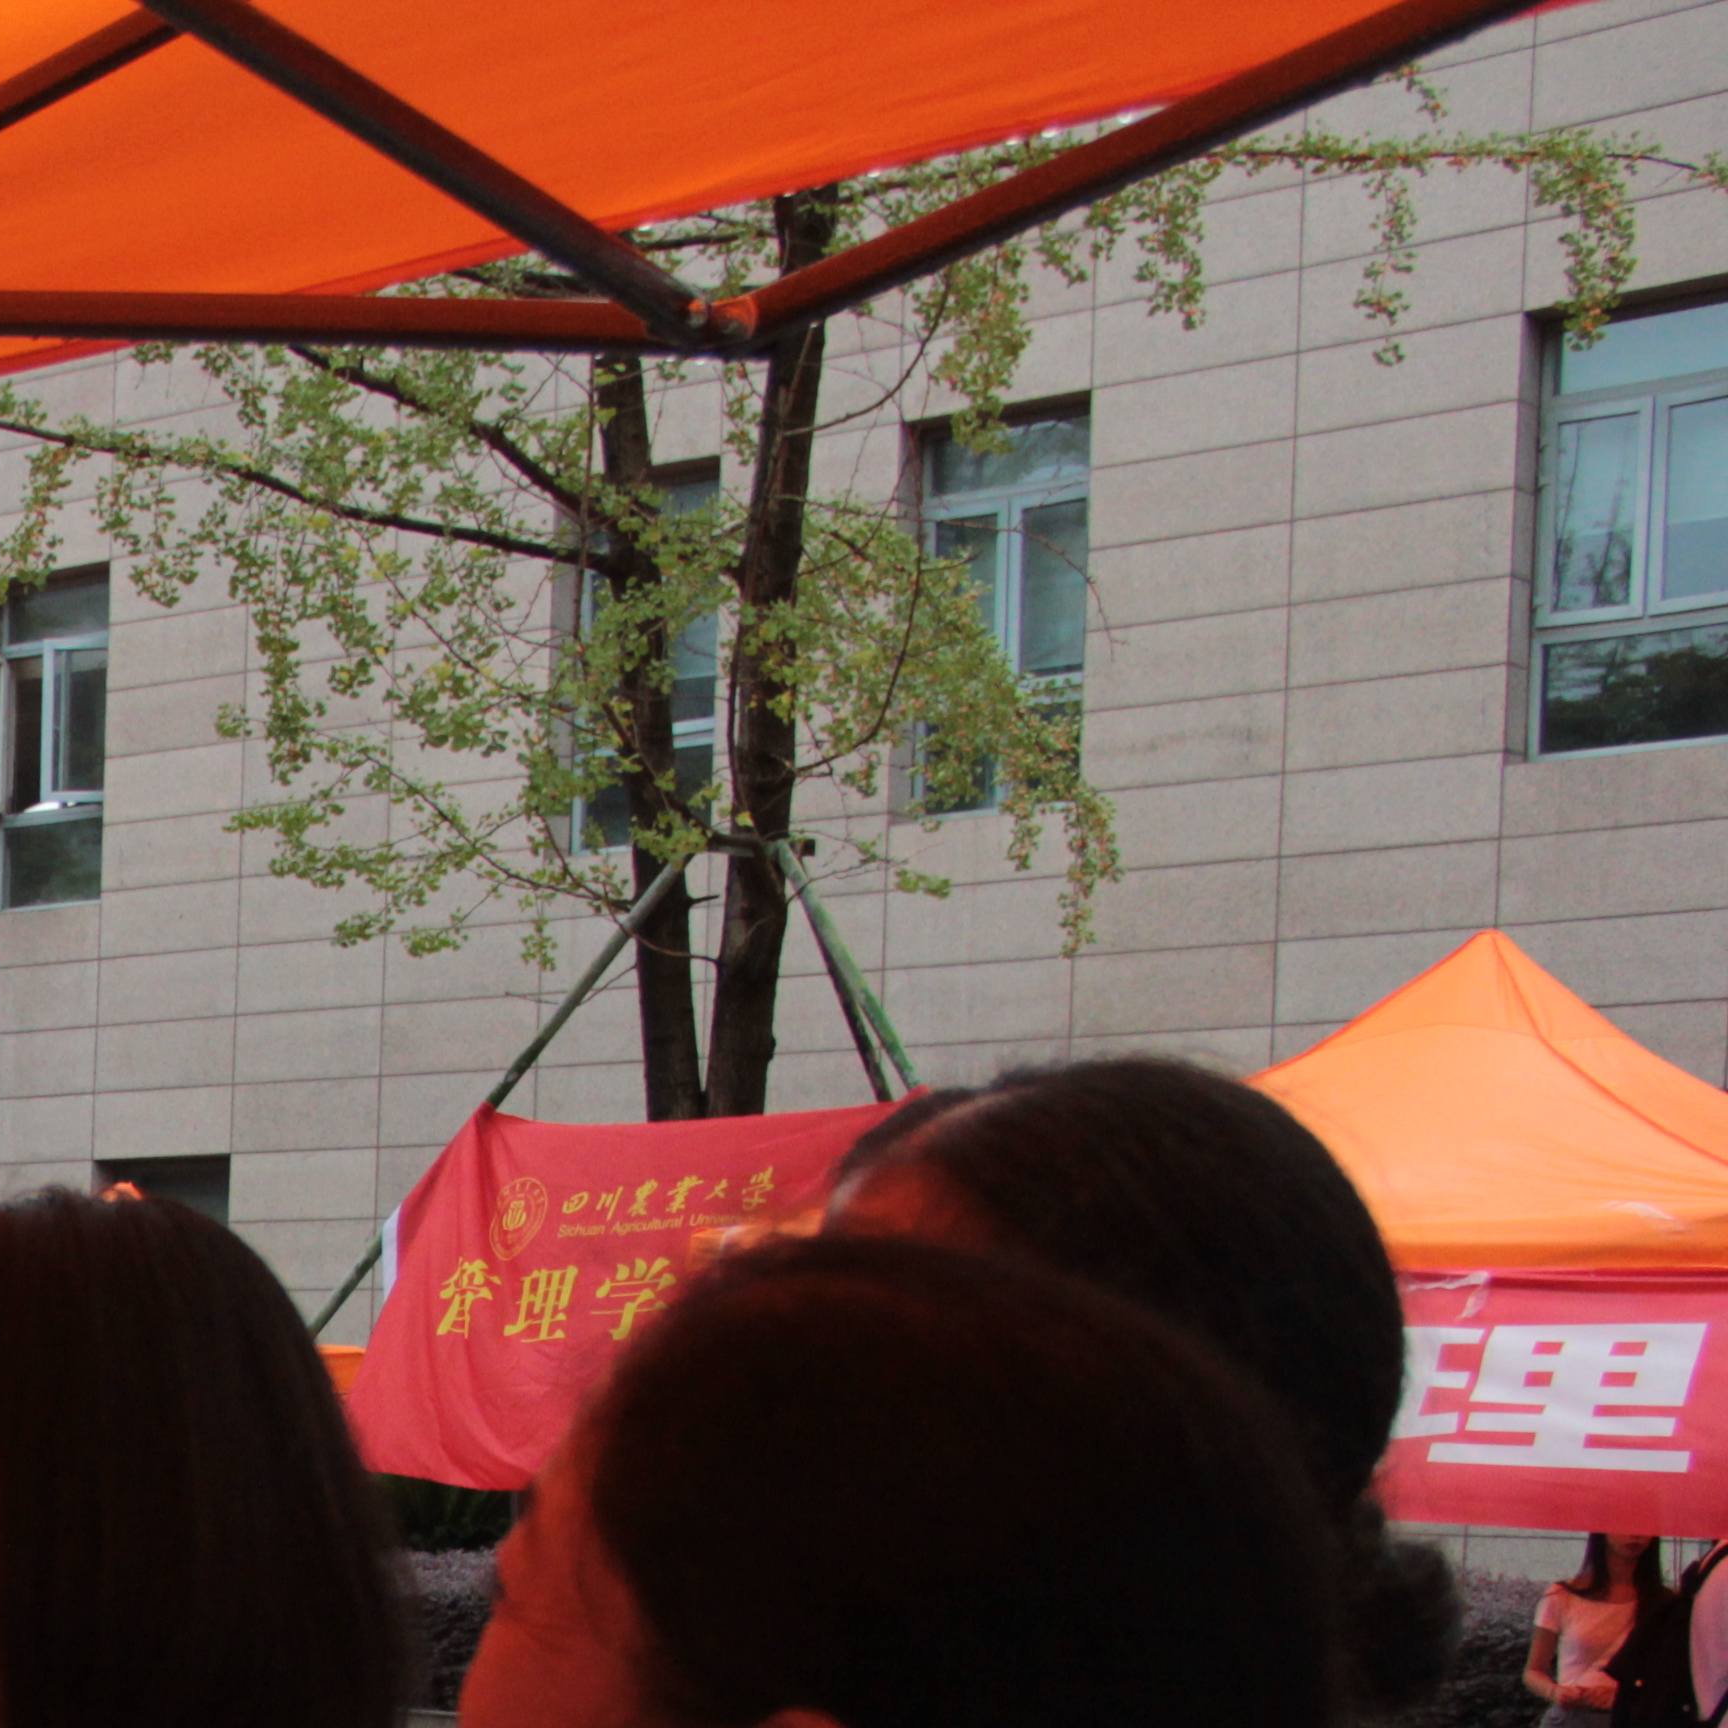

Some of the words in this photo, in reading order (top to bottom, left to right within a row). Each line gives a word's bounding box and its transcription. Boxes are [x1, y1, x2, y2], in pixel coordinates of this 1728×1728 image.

[557, 1223, 606, 1239] Sichuan
[611, 1214, 685, 1236] Agricultural
[435, 1256, 677, 1343] 管理学
